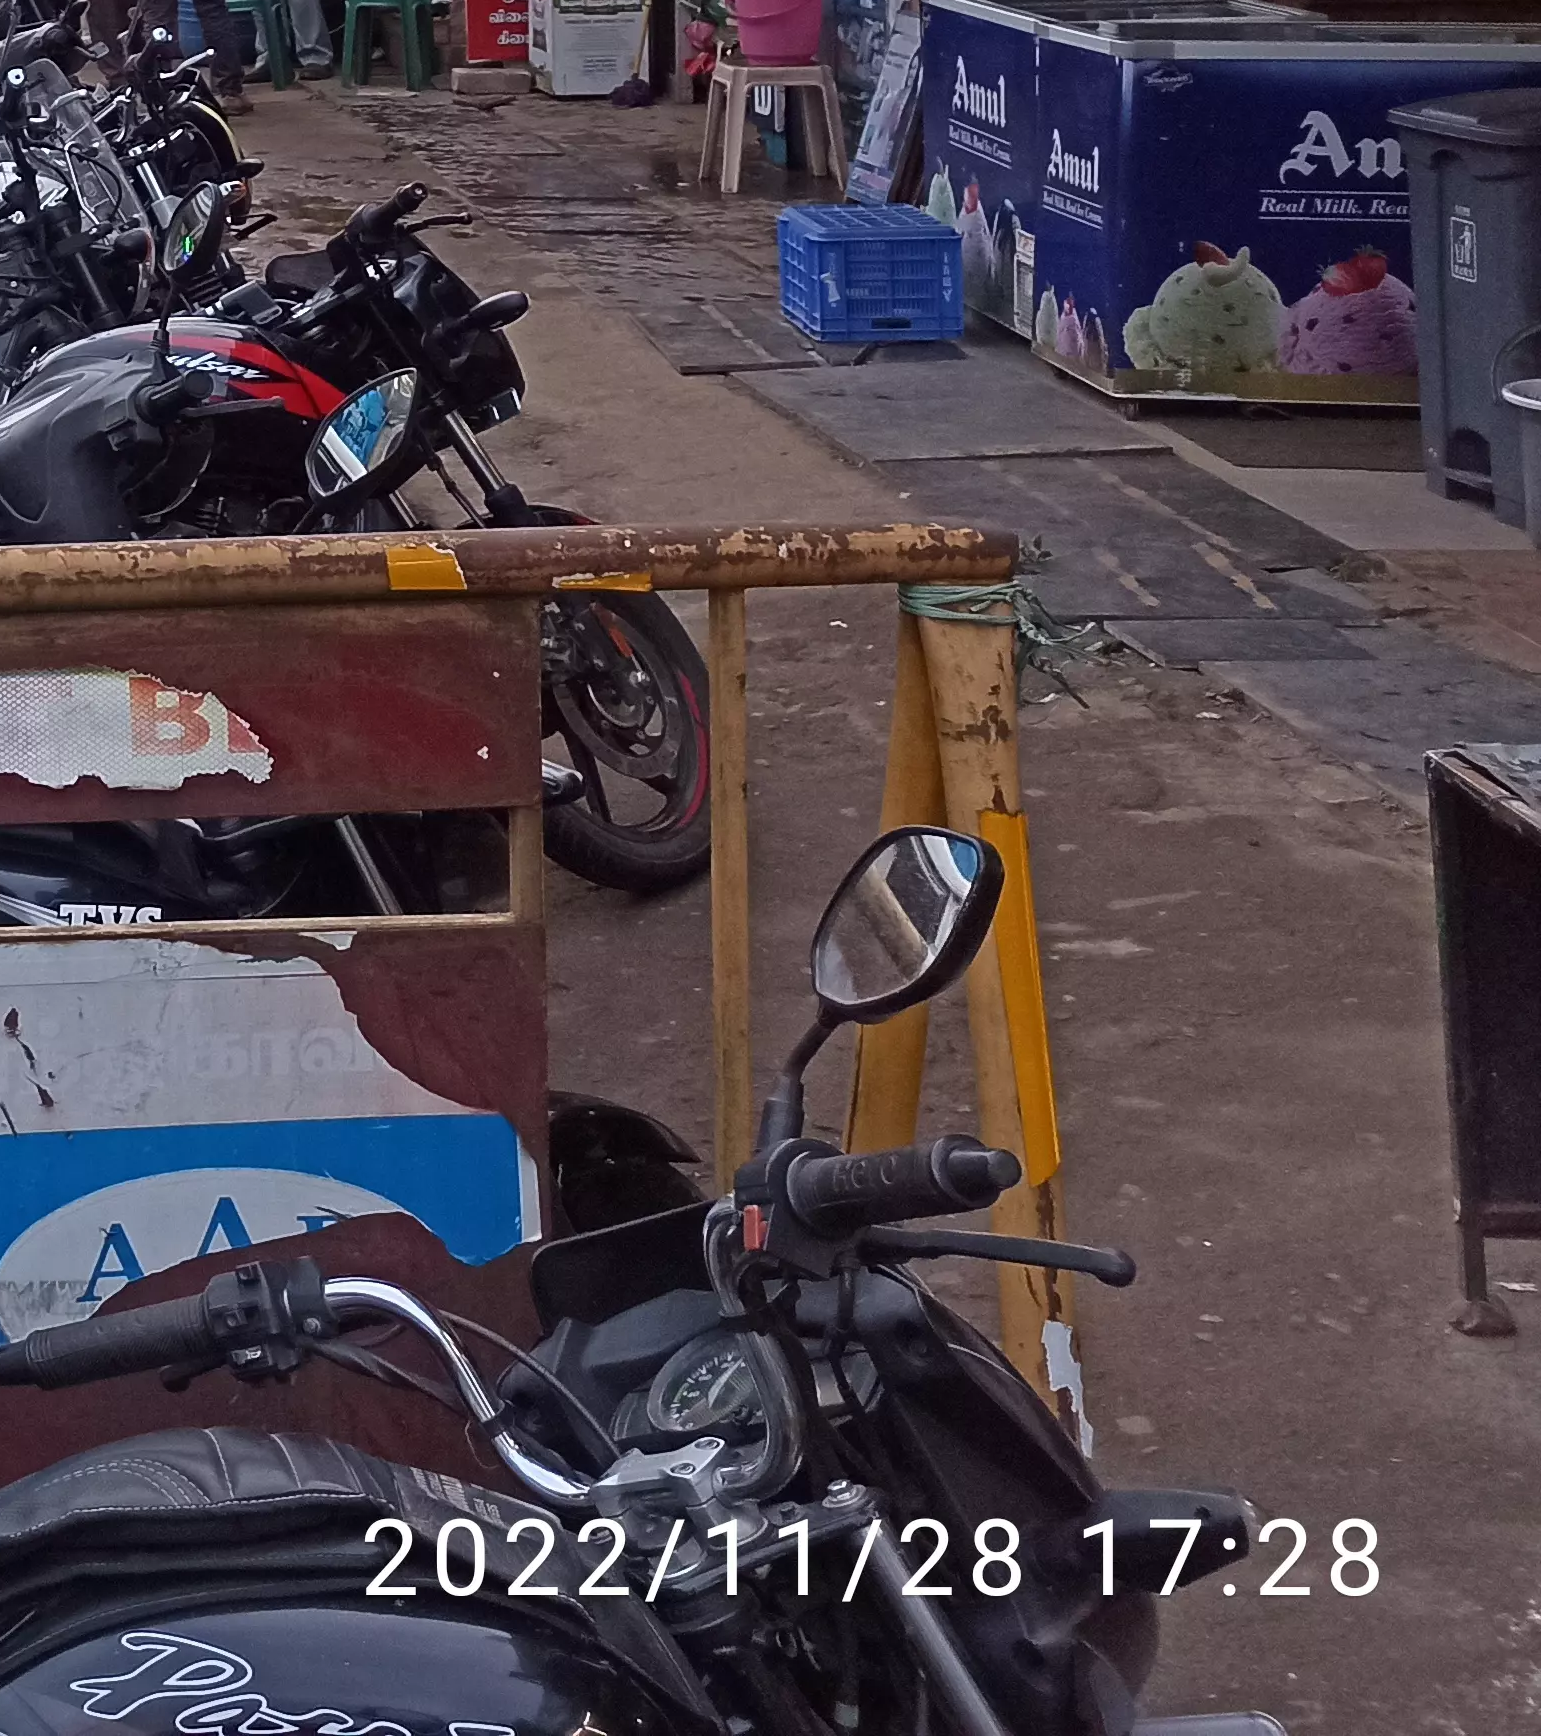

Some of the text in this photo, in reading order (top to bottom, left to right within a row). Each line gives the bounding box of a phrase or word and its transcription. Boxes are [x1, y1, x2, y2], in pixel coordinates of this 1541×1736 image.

[952, 55, 1007, 128] Amul
[1047, 128, 1099, 194] Amul
[1259, 196, 1363, 216] Real Milk.
